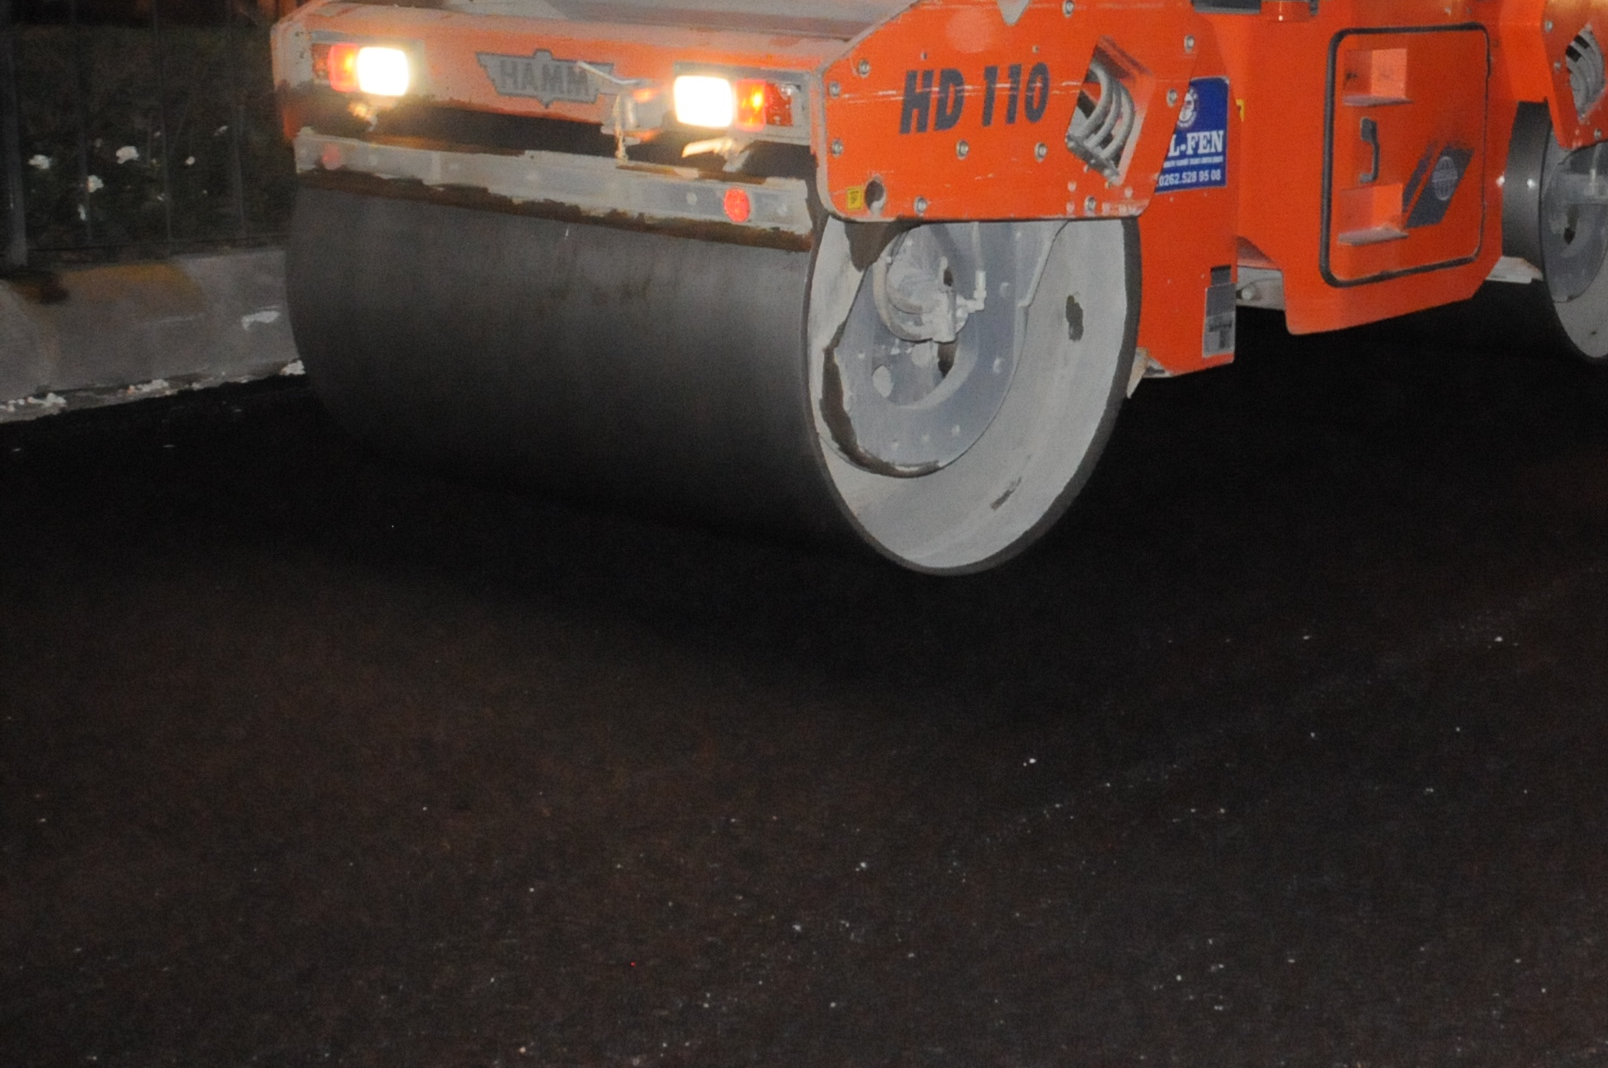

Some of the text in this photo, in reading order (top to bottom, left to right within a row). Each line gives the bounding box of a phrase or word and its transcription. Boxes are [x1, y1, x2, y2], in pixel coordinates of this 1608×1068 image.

[500, 59, 591, 97] HAMM
[899, 61, 1050, 135] HD 110
